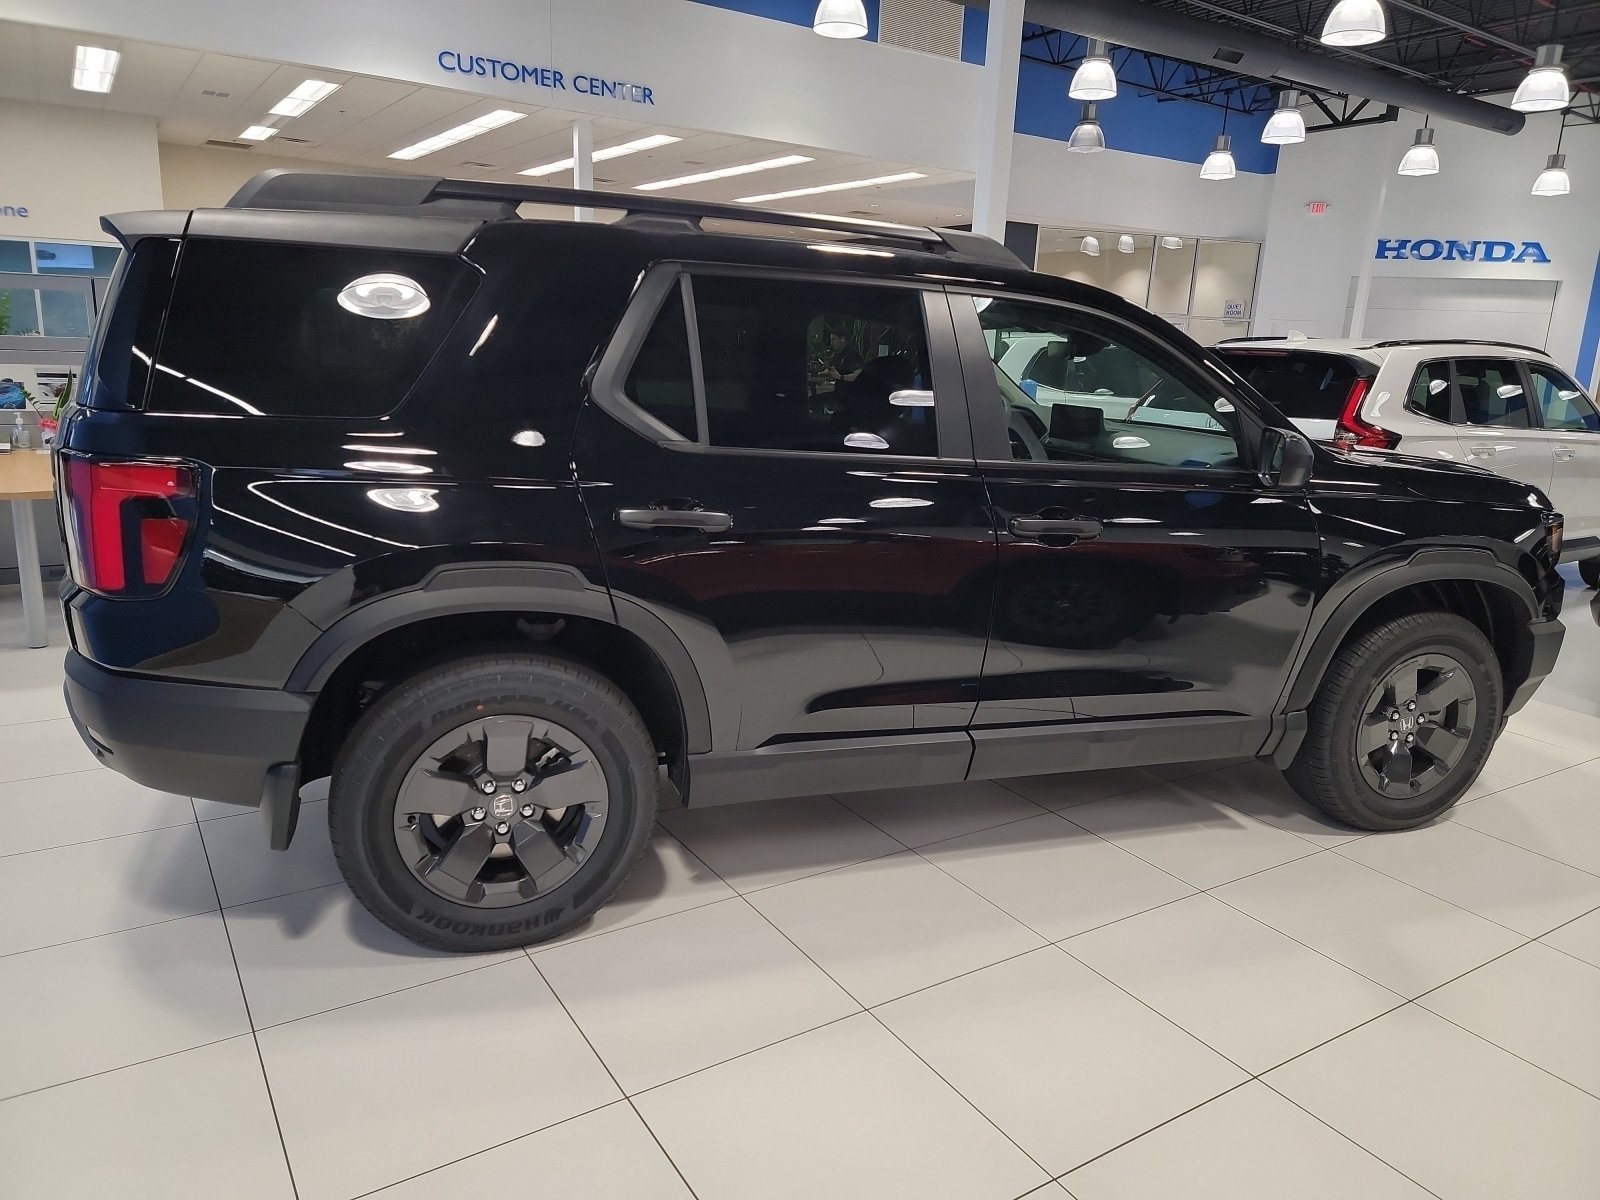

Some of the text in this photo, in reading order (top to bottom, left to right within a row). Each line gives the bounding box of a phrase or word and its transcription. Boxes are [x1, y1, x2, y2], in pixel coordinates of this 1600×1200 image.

[438, 50, 655, 105] CUSTOMER CENTER
[0, 206, 29, 218] ne
[1375, 238, 1551, 264] HONDA
